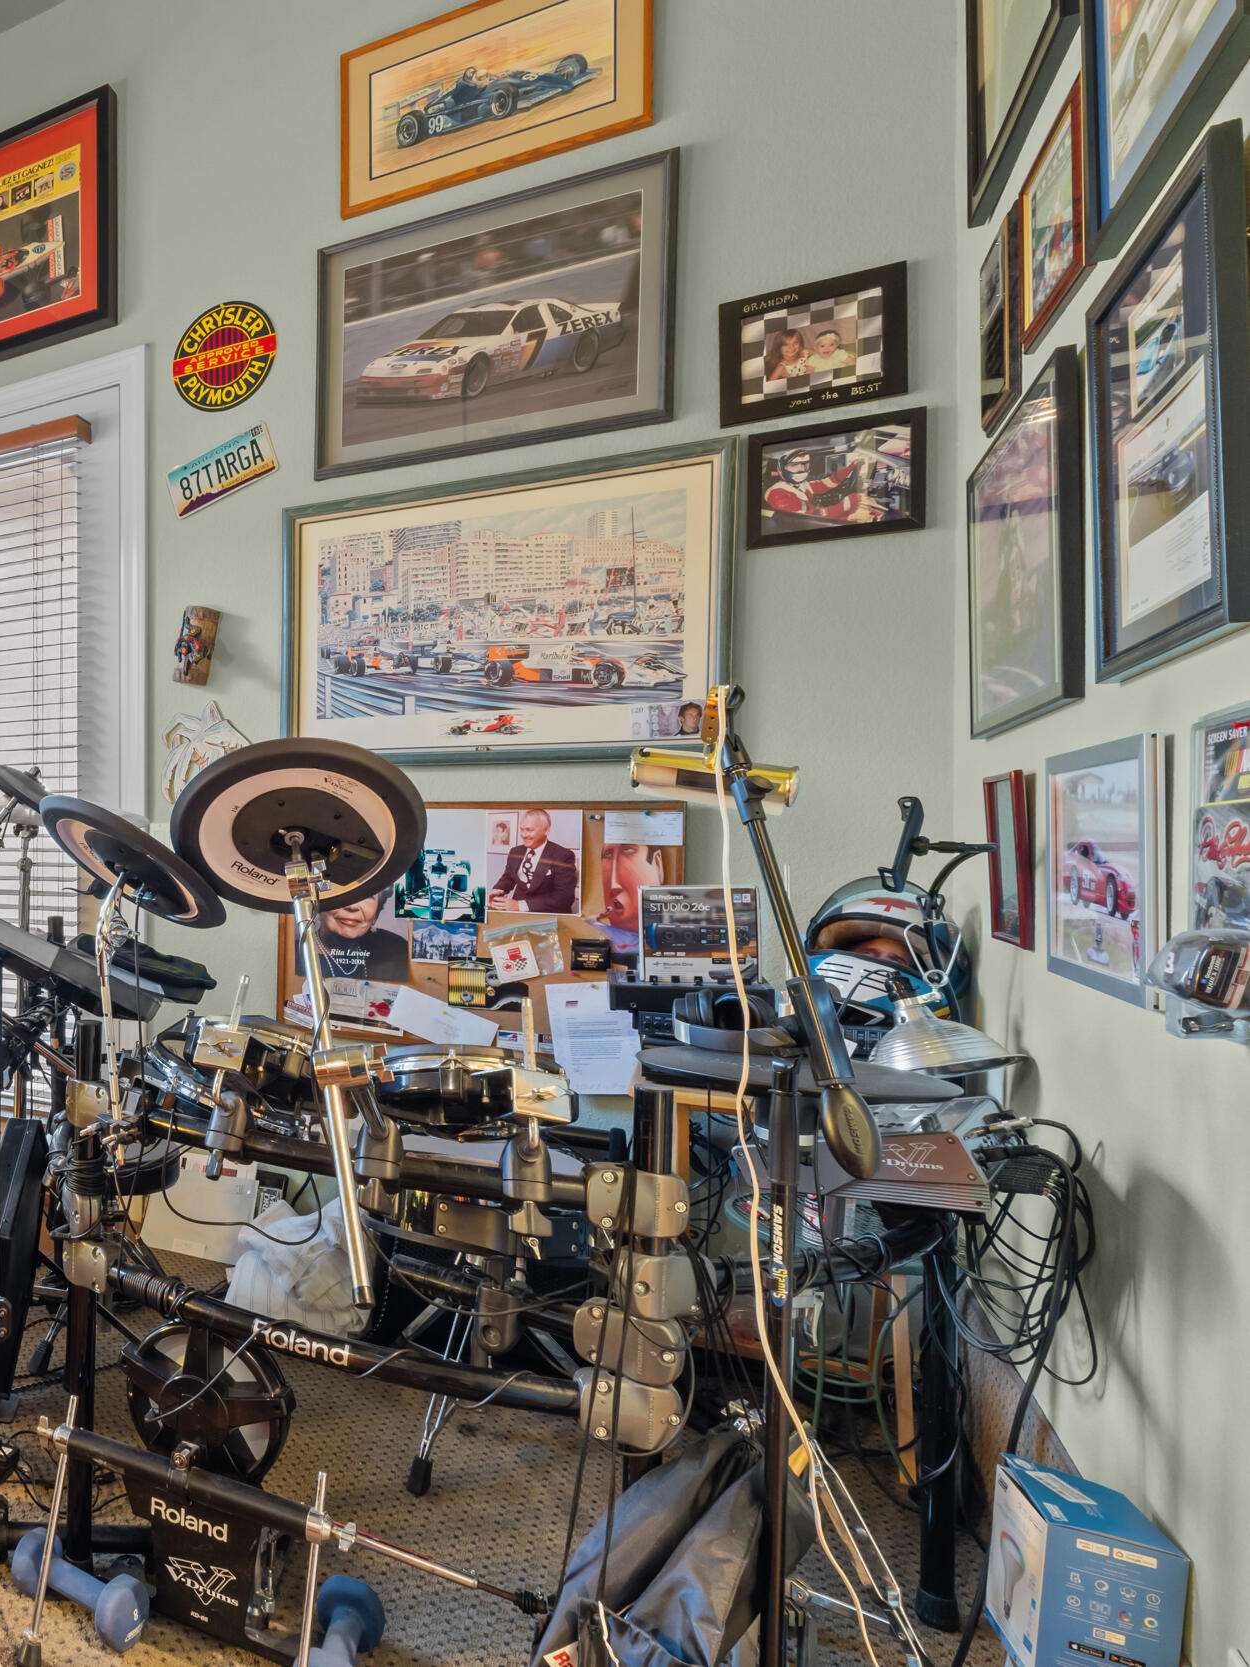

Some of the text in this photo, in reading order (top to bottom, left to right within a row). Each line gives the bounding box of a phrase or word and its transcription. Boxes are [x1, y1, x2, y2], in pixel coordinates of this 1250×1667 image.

[742, 292, 800, 314] GRANDPA
[183, 307, 264, 354] CHRYSLER
[557, 311, 615, 336] ZEREX
[183, 345, 265, 374] SERVICE
[190, 340, 260, 364] APPROVED
[518, 327, 549, 372] 7
[182, 360, 266, 405] PLYMOUTH
[851, 381, 883, 396] BEST
[179, 438, 265, 500] 87TARGA
[1228, 726, 1248, 741] SAVER
[230, 859, 279, 887] Roland
[649, 902, 711, 912] STUDIO 26c
[330, 948, 370, 957] Rita Lavoie
[881, 1155, 944, 1172] -Drums
[772, 1203, 783, 1264] SAMSON
[253, 1318, 351, 1367] Roland
[151, 1496, 229, 1544] Roland
[164, 1562, 239, 1608] V-Drums
